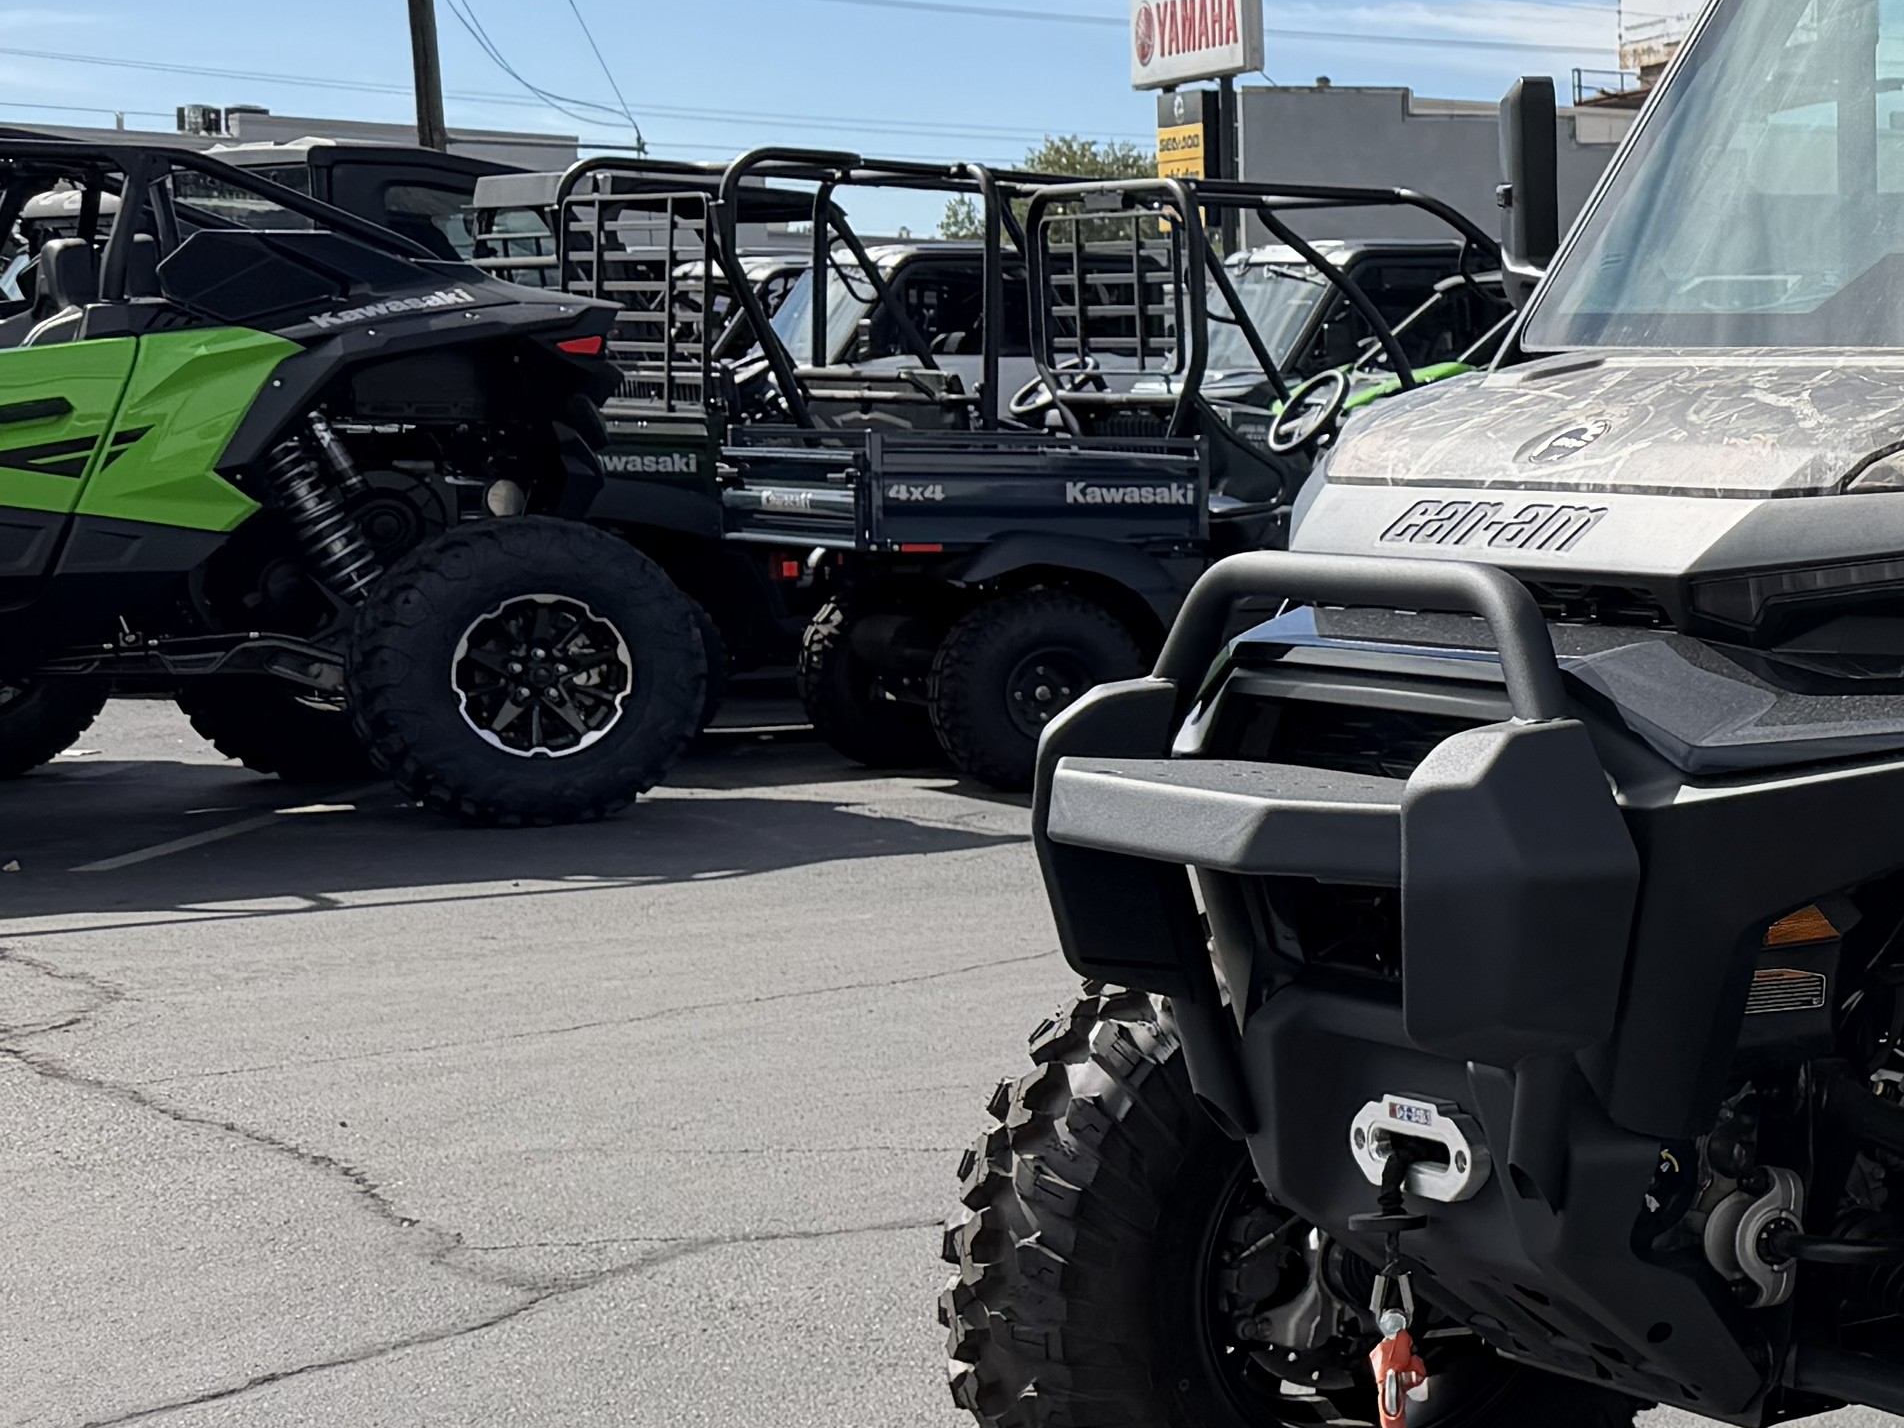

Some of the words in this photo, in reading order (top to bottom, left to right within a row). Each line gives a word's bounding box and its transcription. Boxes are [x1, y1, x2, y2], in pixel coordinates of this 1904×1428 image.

[309, 288, 476, 329] Kawasaki
[598, 453, 697, 473] wasaki
[1066, 481, 1194, 506] Kawasaki
[1380, 499, 1609, 553] can-am
